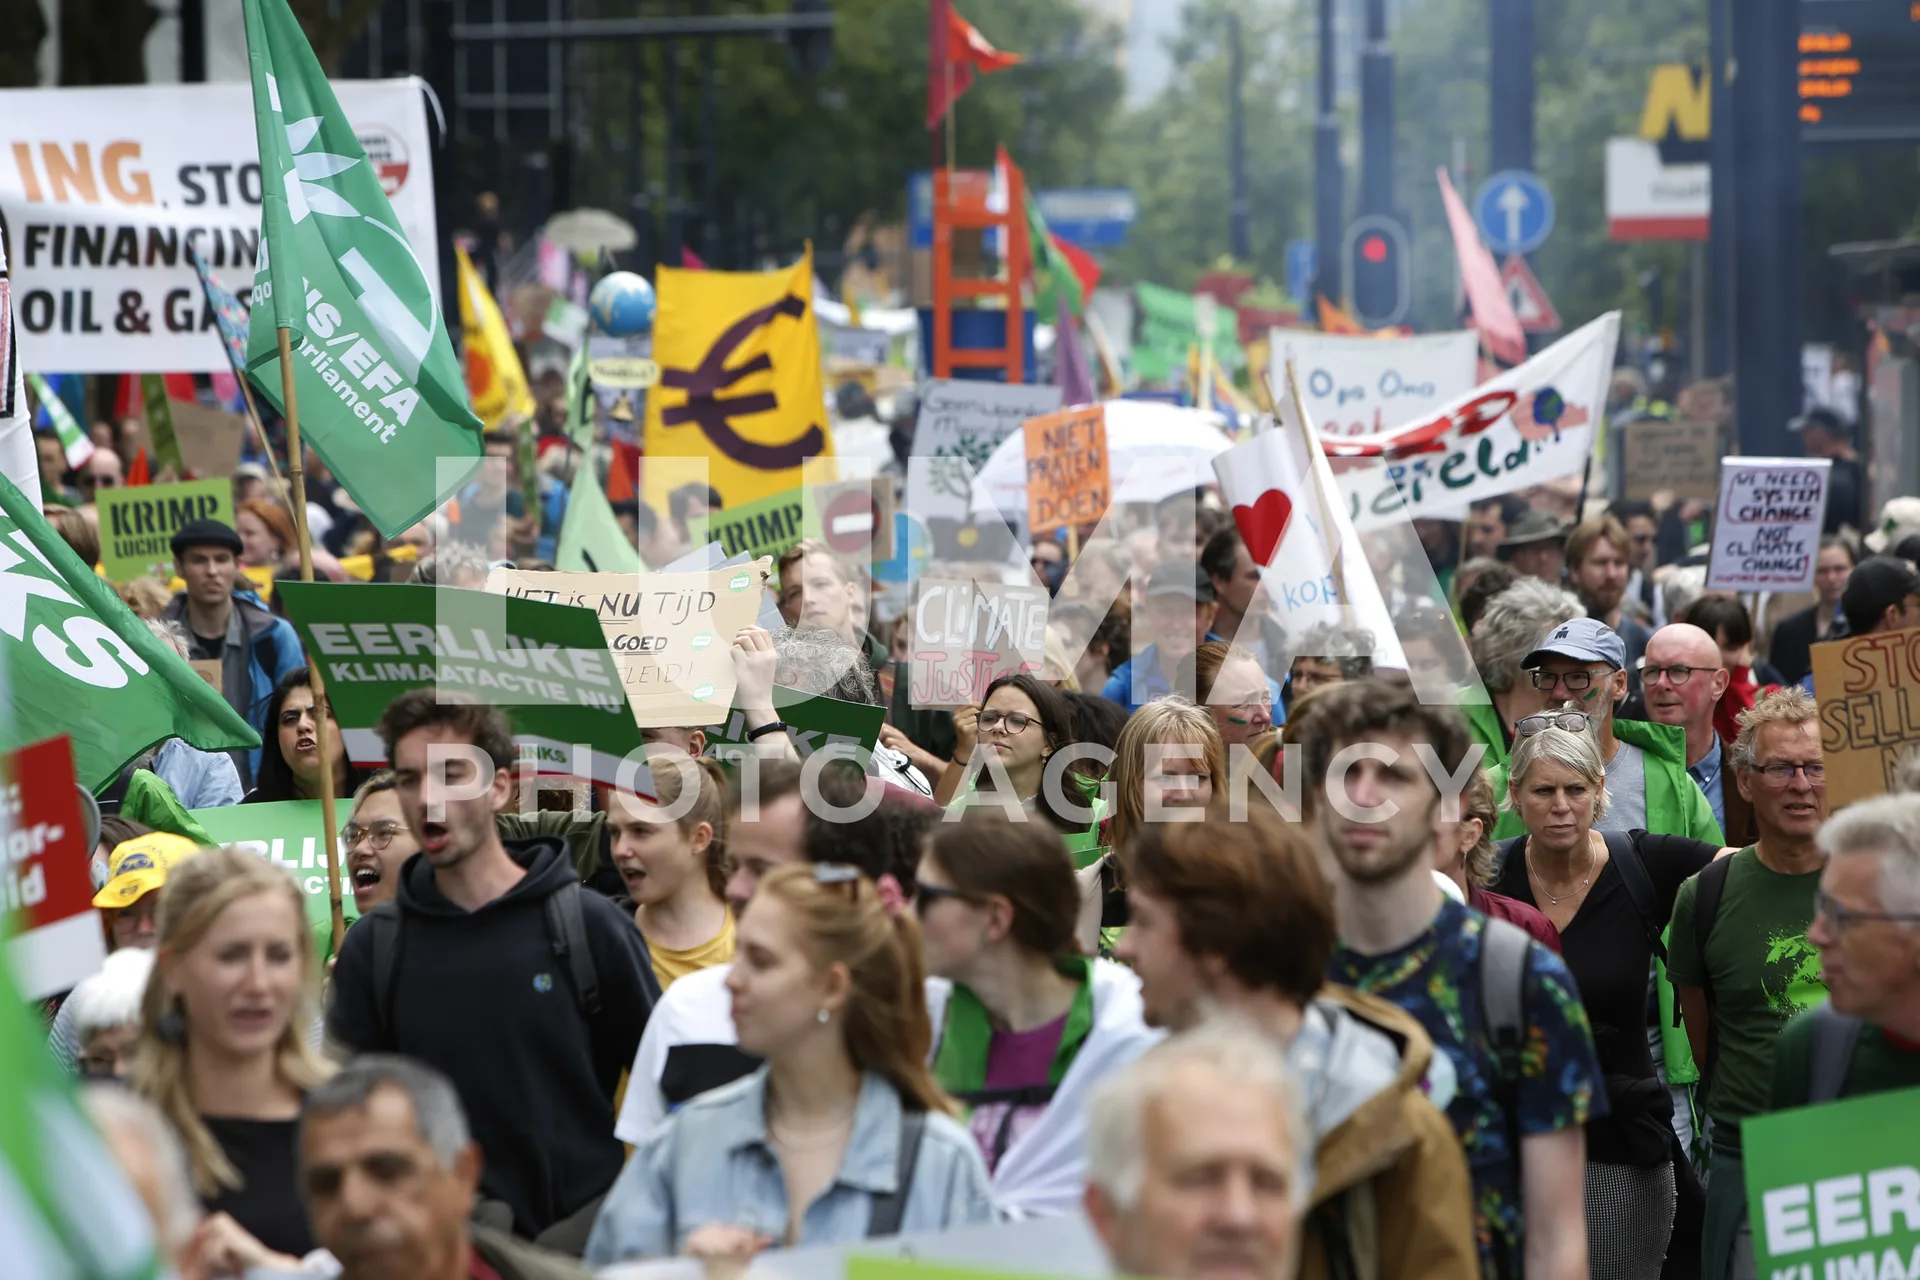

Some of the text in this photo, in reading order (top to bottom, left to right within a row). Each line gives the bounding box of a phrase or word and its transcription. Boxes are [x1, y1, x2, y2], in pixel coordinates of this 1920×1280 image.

[178, 163, 263, 206] STO
[24, 223, 260, 268] FINANCIN
[21, 288, 102, 334] OIL
[114, 290, 152, 334] &
[1043, 417, 1100, 451] NIET
[1765, 471, 1819, 486] NEED
[1036, 488, 1107, 524] DOEN
[1752, 487, 1820, 506] SYSTEM
[110, 494, 219, 537] KRIMP
[1739, 506, 1813, 523] CHANGE
[114, 534, 172, 559] LUCHT
[1726, 540, 1805, 557] CLIMATE
[1756, 525, 1793, 542] NOT
[1741, 557, 1804, 573] CHANGE
[597, 592, 642, 617] NU
[307, 623, 613, 687] EERLIJKE
[329, 662, 622, 715] KLIMAATACTIE NU
[1820, 687, 1920, 753] SELL
[1761, 1165, 1920, 1257] EER
